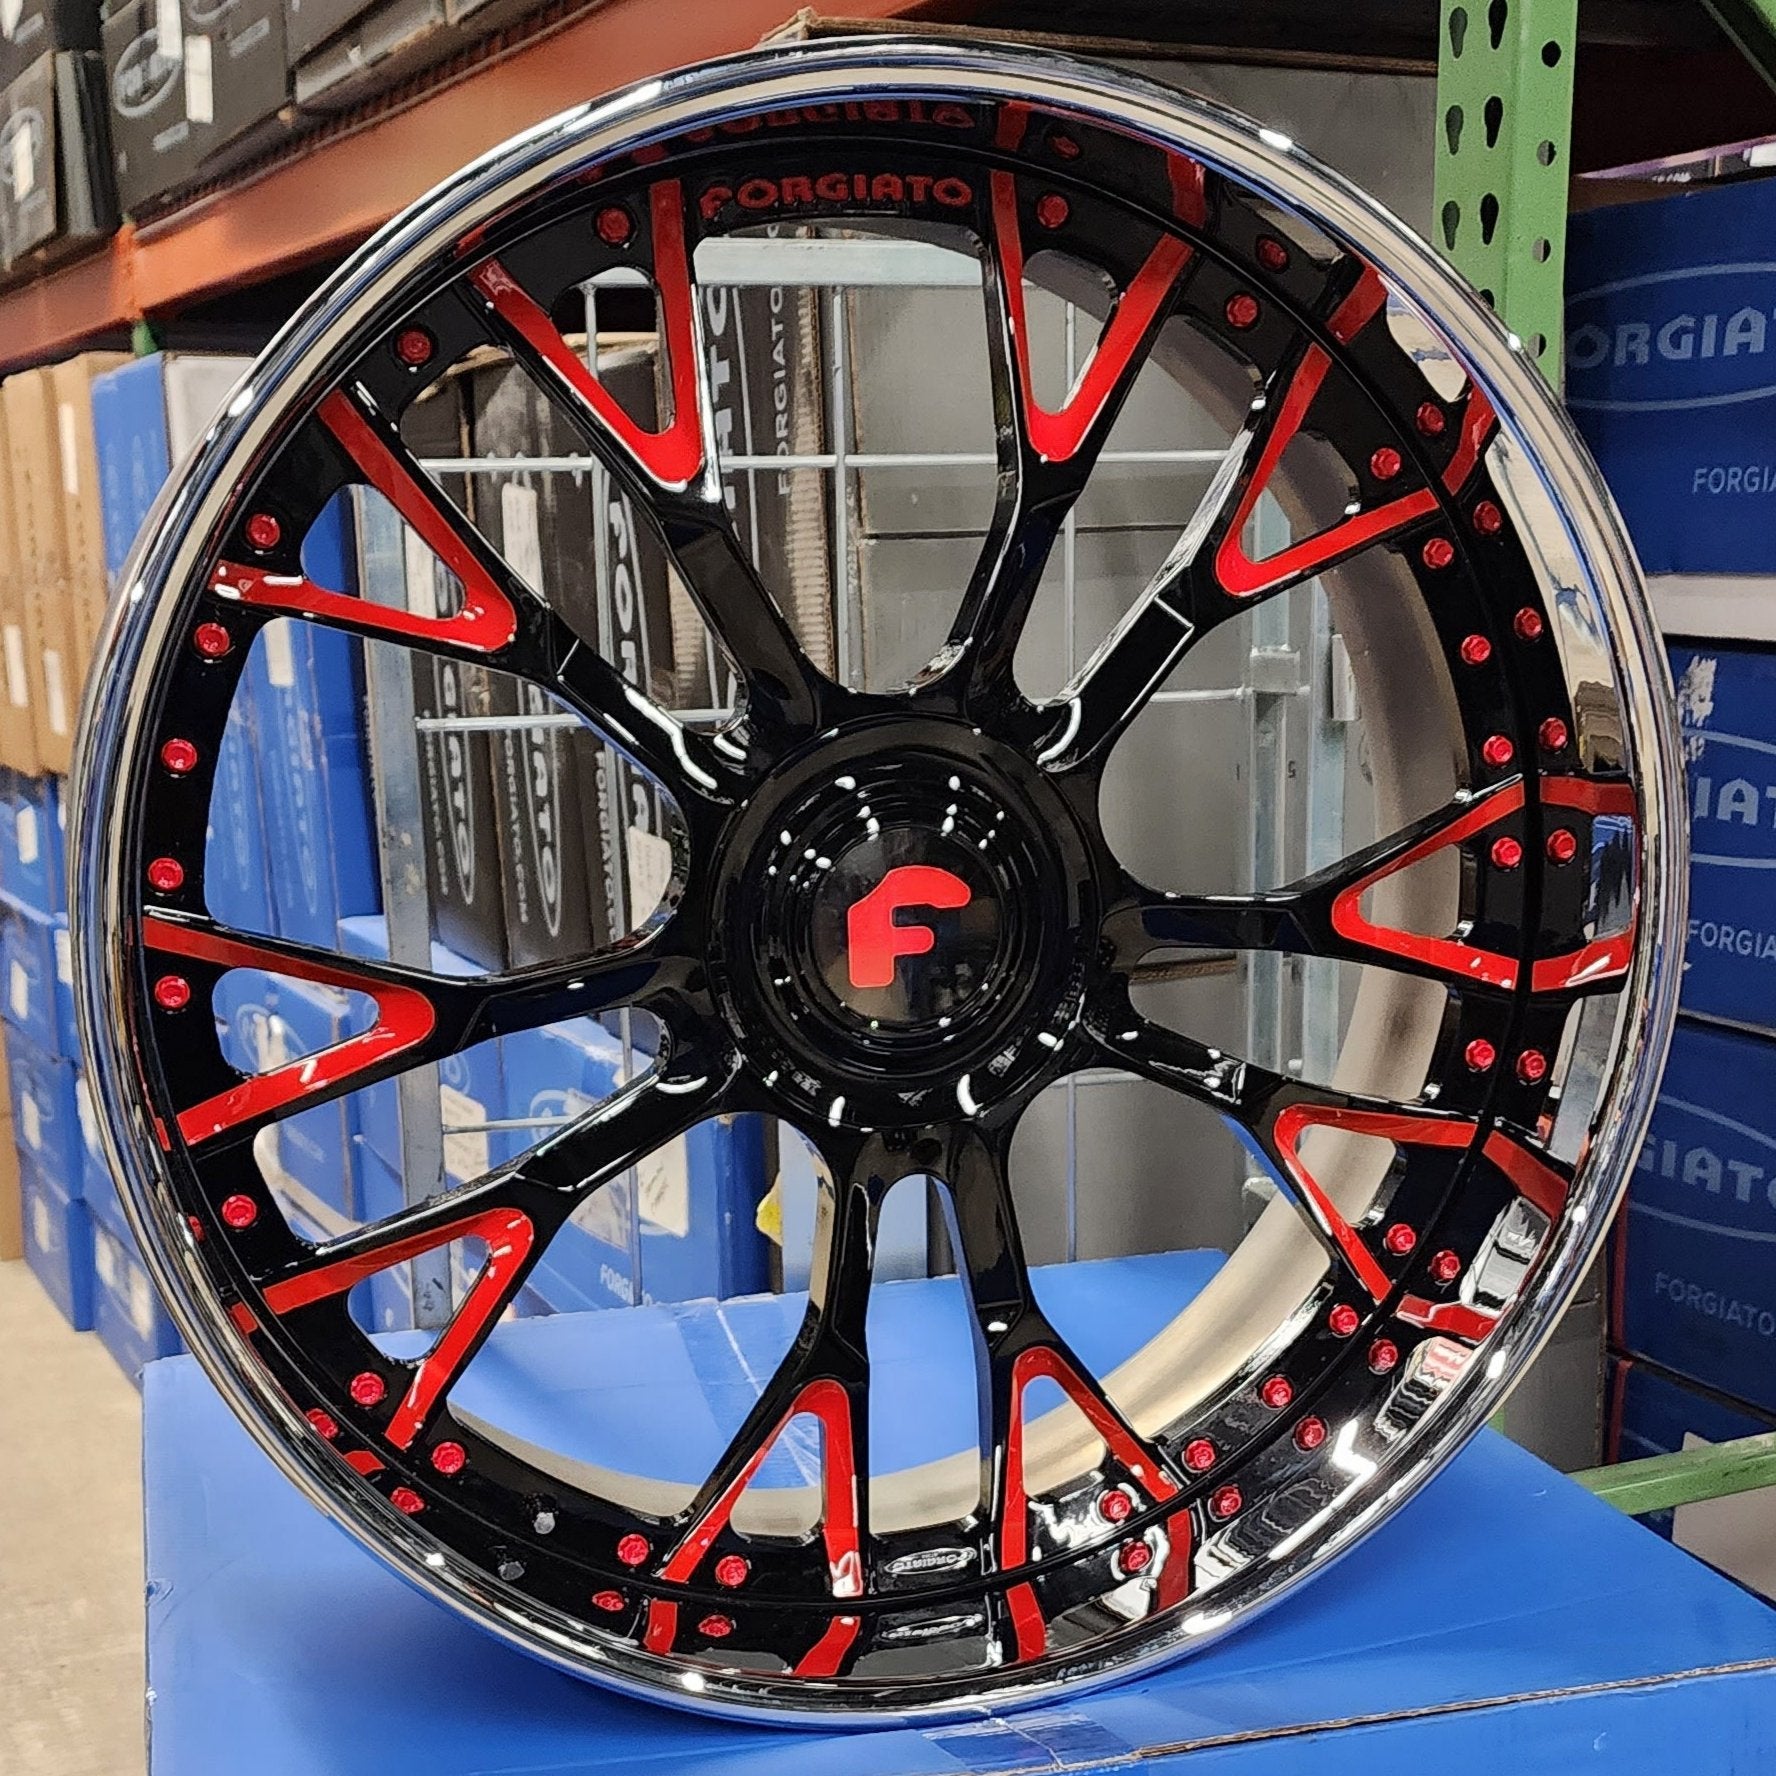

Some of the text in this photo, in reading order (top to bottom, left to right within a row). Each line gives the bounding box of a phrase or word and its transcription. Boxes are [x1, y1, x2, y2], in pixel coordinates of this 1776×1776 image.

[700, 172, 973, 221] FORGIATO
[1565, 306, 1776, 369] ORGIA
[848, 865, 971, 988] F
